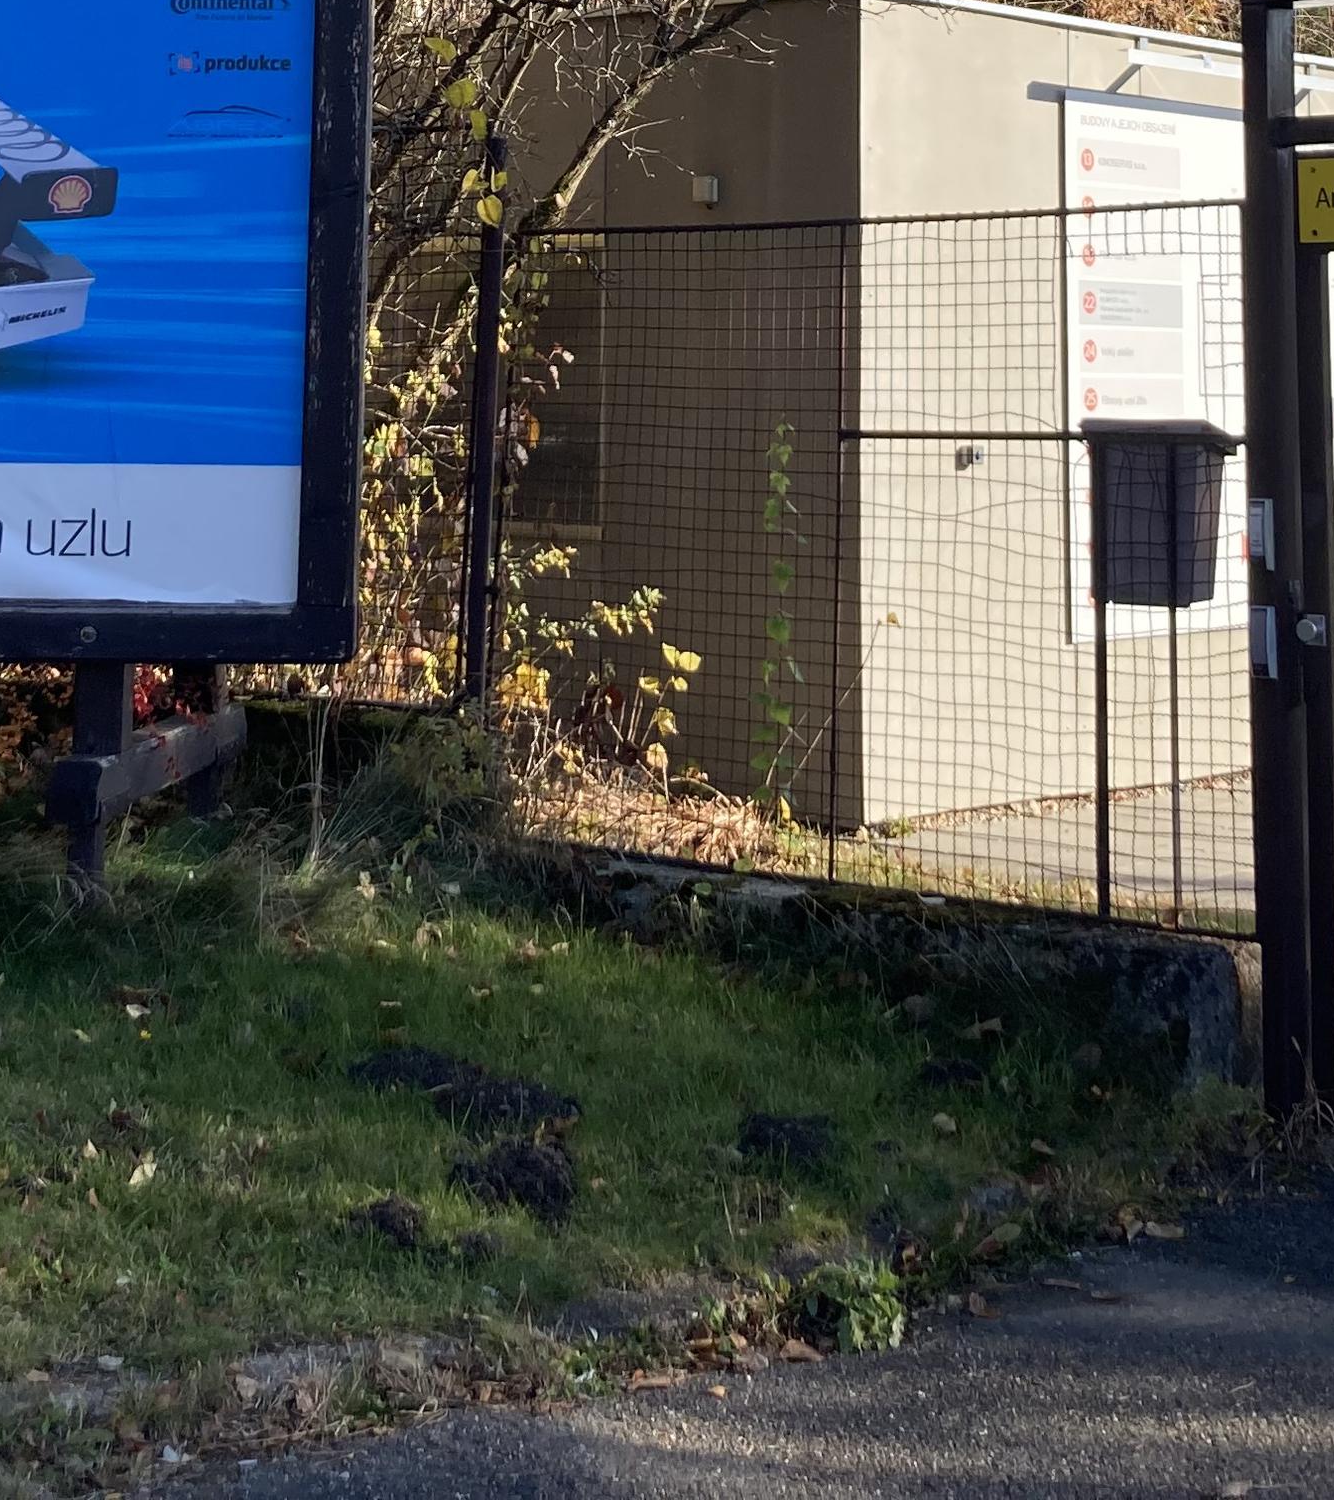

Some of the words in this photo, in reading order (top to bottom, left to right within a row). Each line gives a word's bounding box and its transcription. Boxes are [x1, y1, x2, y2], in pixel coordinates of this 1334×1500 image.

[205, 54, 292, 74] produkce
[8, 306, 66, 324] MICHELIN
[26, 507, 132, 557] uzlu
